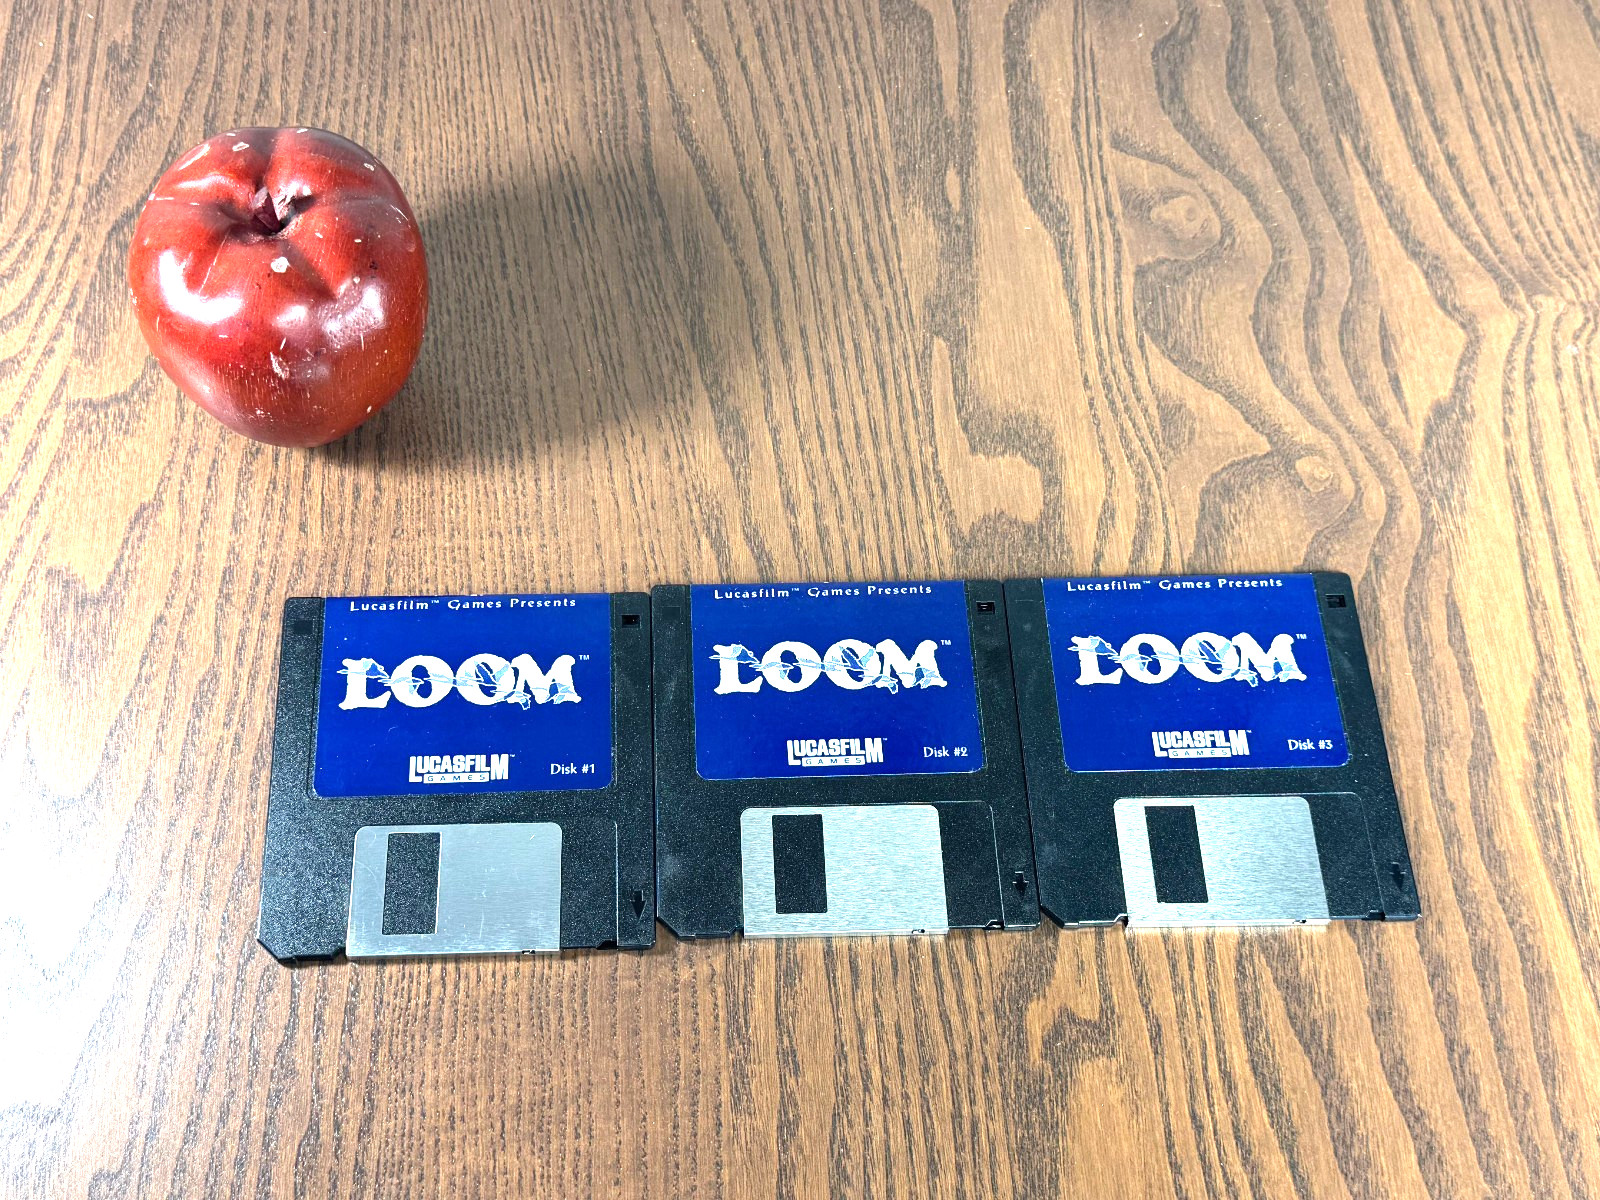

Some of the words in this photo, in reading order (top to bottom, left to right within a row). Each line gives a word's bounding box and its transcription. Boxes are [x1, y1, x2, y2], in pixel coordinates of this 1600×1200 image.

[1158, 579, 1211, 590] Games
[1218, 578, 1283, 588] Presents
[807, 587, 860, 598] Games
[867, 585, 932, 596] Presents
[447, 598, 502, 611] Games
[510, 597, 576, 608] Presents
[1287, 739, 1315, 750] Disk
[1318, 740, 1333, 750] #3
[923, 746, 950, 758] Disk
[954, 746, 968, 757] #2
[805, 757, 862, 765] GAMES
[550, 763, 577, 775] Disk
[581, 763, 595, 774] #1
[428, 774, 486, 782] GAMES
